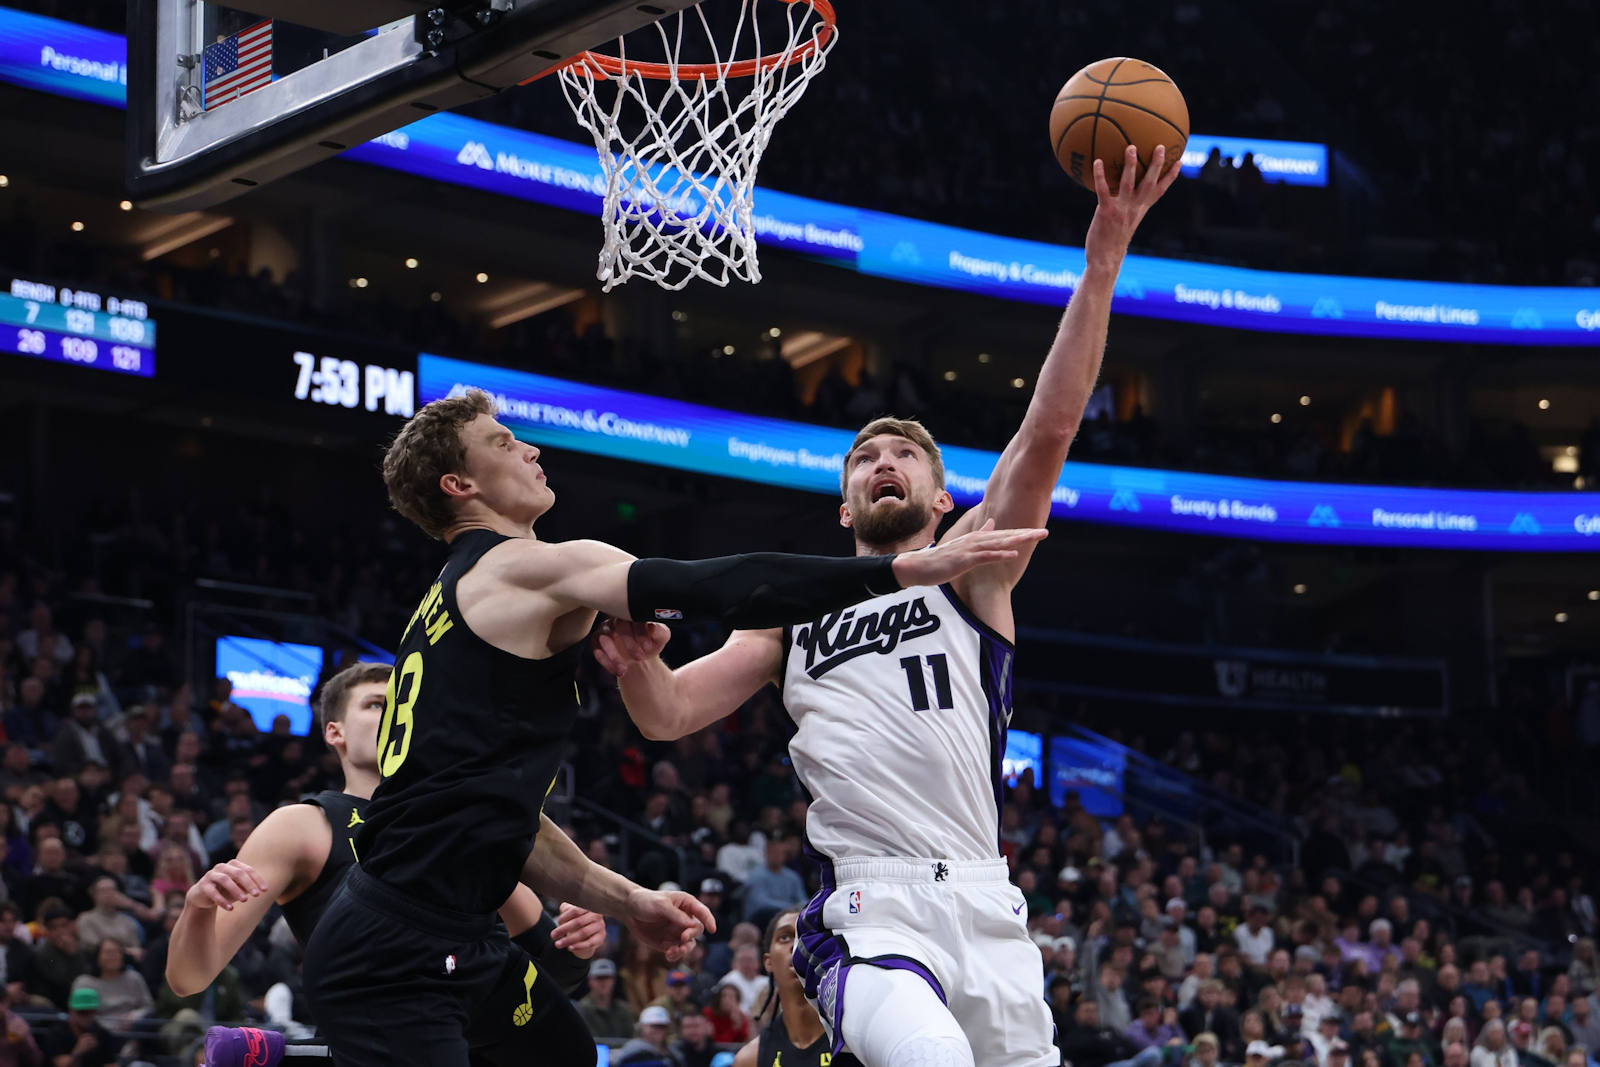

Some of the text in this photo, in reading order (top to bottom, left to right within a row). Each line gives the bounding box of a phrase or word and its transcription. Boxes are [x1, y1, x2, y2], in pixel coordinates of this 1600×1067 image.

[41, 45, 118, 82] Personal
[804, 223, 864, 252] Benefits
[949, 250, 1008, 283] Property
[24, 301, 40, 324] 7
[1174, 283, 1220, 310] Surety
[1234, 290, 1282, 313] Bonds
[1375, 300, 1480, 325] Personal Lines
[293, 351, 414, 418] 7:53 PM
[728, 436, 797, 467] Employee
[1171, 494, 1217, 521] Surety
[1231, 500, 1278, 523] Bonds
[1372, 508, 1478, 531] Personal Lines
[796, 596, 941, 681] Kings
[900, 653, 954, 711] 11
